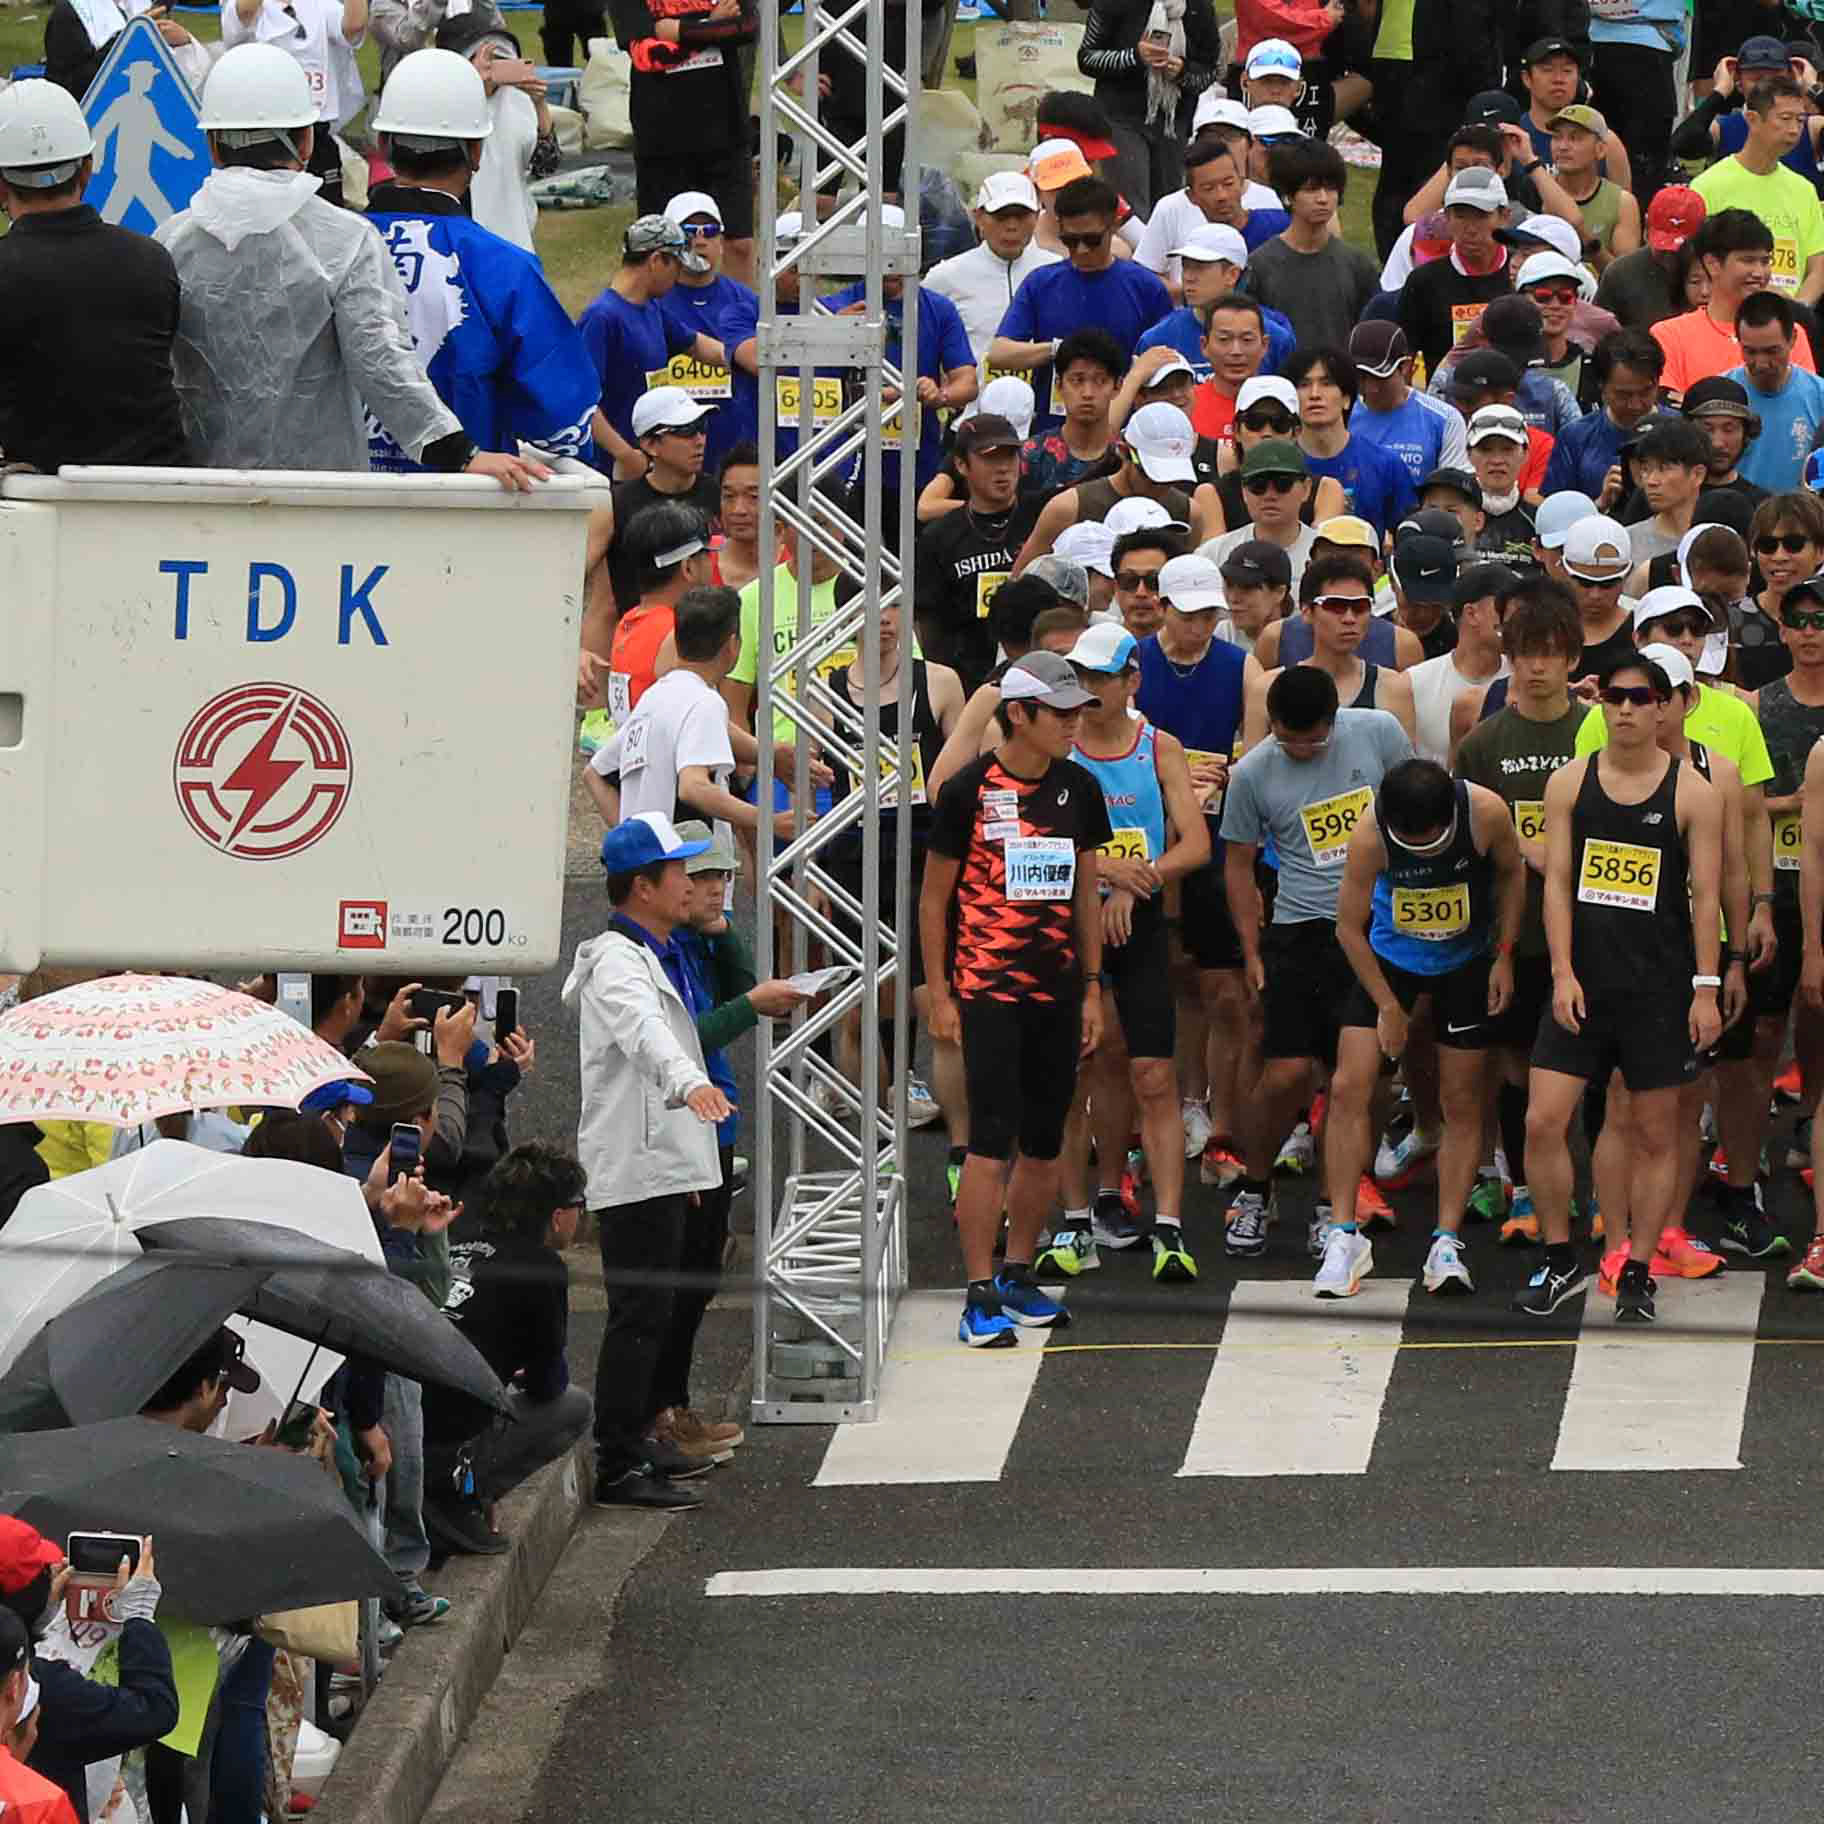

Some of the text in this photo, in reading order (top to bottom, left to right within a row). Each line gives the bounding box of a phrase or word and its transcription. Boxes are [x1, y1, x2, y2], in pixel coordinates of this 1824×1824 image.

[780, 387, 836, 410] 605
[952, 548, 1012, 578] ISHIDA
[1584, 852, 1655, 888] 5856
[1400, 898, 1464, 922] 5301
[441, 908, 505, 947] 200
